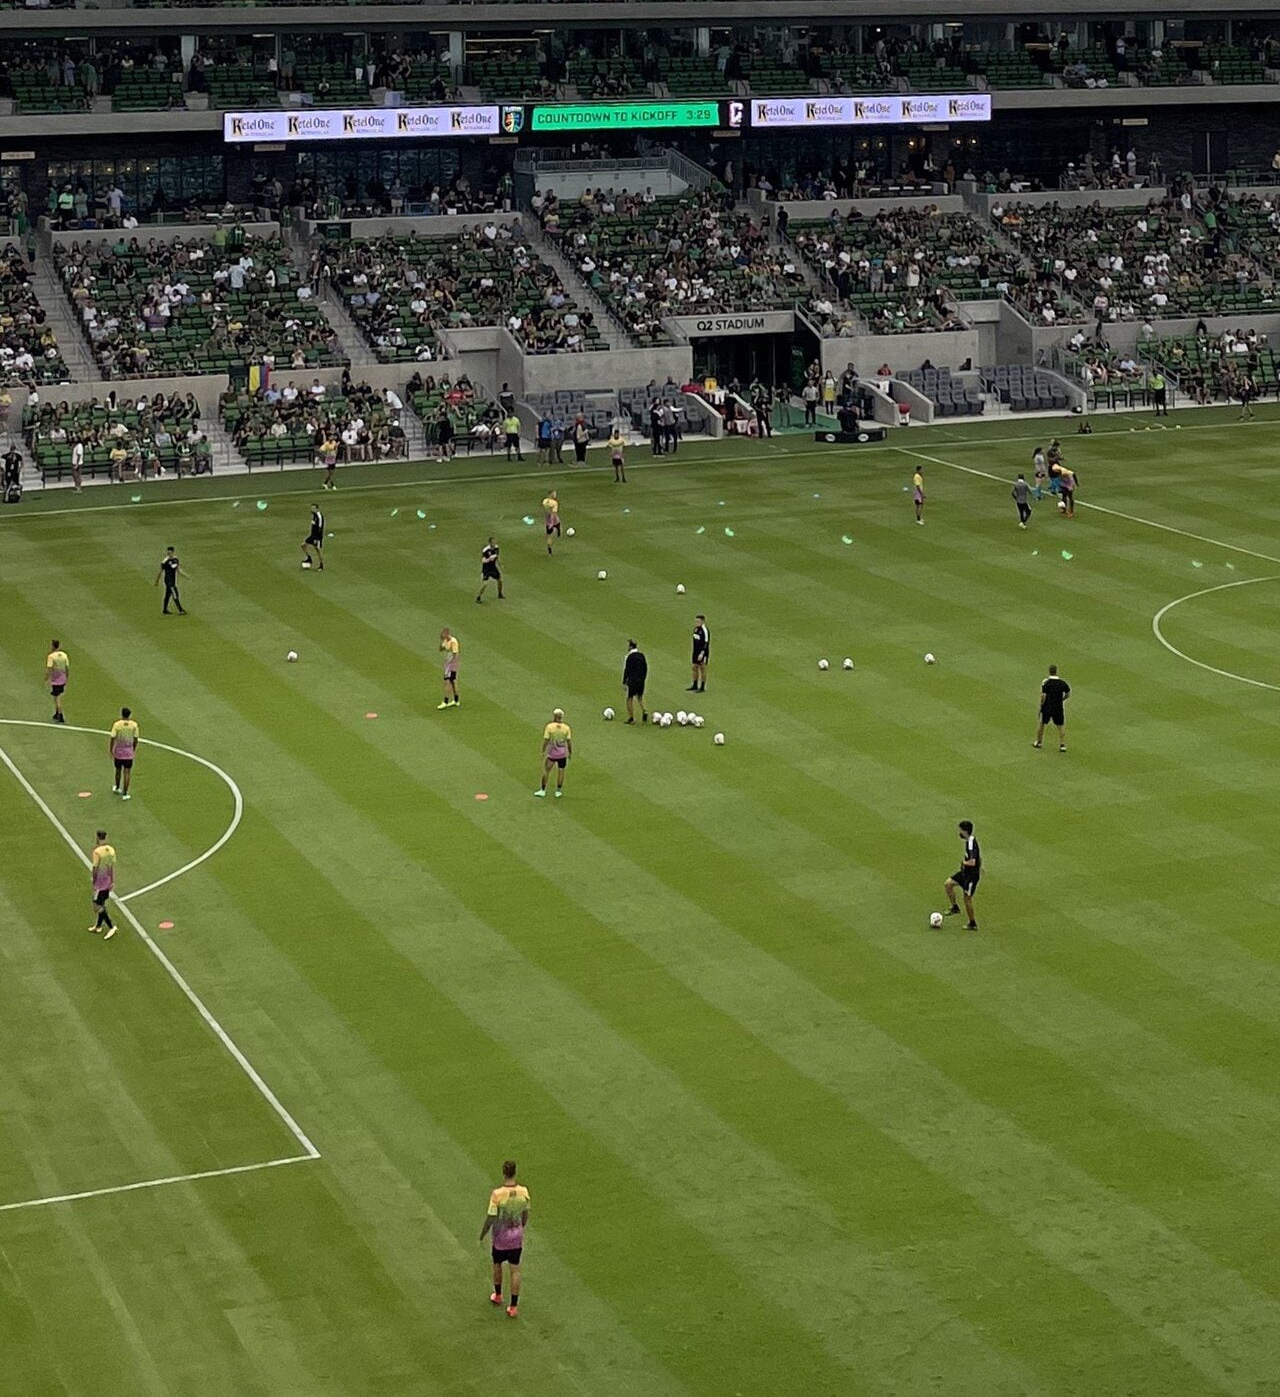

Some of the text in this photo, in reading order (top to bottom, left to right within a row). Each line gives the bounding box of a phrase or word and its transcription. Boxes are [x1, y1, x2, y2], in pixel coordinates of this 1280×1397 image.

[538, 109, 711, 124] COUNTDOWN TO KICKOFF 3:29
[757, 103, 779, 122] Ketel
[780, 105, 795, 116] One
[806, 102, 827, 121] Ketel
[828, 104, 843, 114] One
[854, 101, 875, 119] Ketel
[876, 103, 891, 113] One
[901, 100, 923, 118] Ketel
[923, 102, 938, 112] One
[949, 99, 970, 117] Ketel
[971, 101, 985, 111] One
[231, 117, 256, 137] Ketel
[258, 119, 275, 130] One
[287, 115, 312, 135] Ketel
[313, 117, 330, 128] One
[343, 113, 367, 133] Ketel
[368, 115, 385, 127] One
[397, 112, 421, 132] Ketel
[422, 114, 439, 126] One
[450, 111, 475, 131] Ketel
[476, 112, 493, 124] One
[697, 318, 765, 331] Q2 STADIUM
